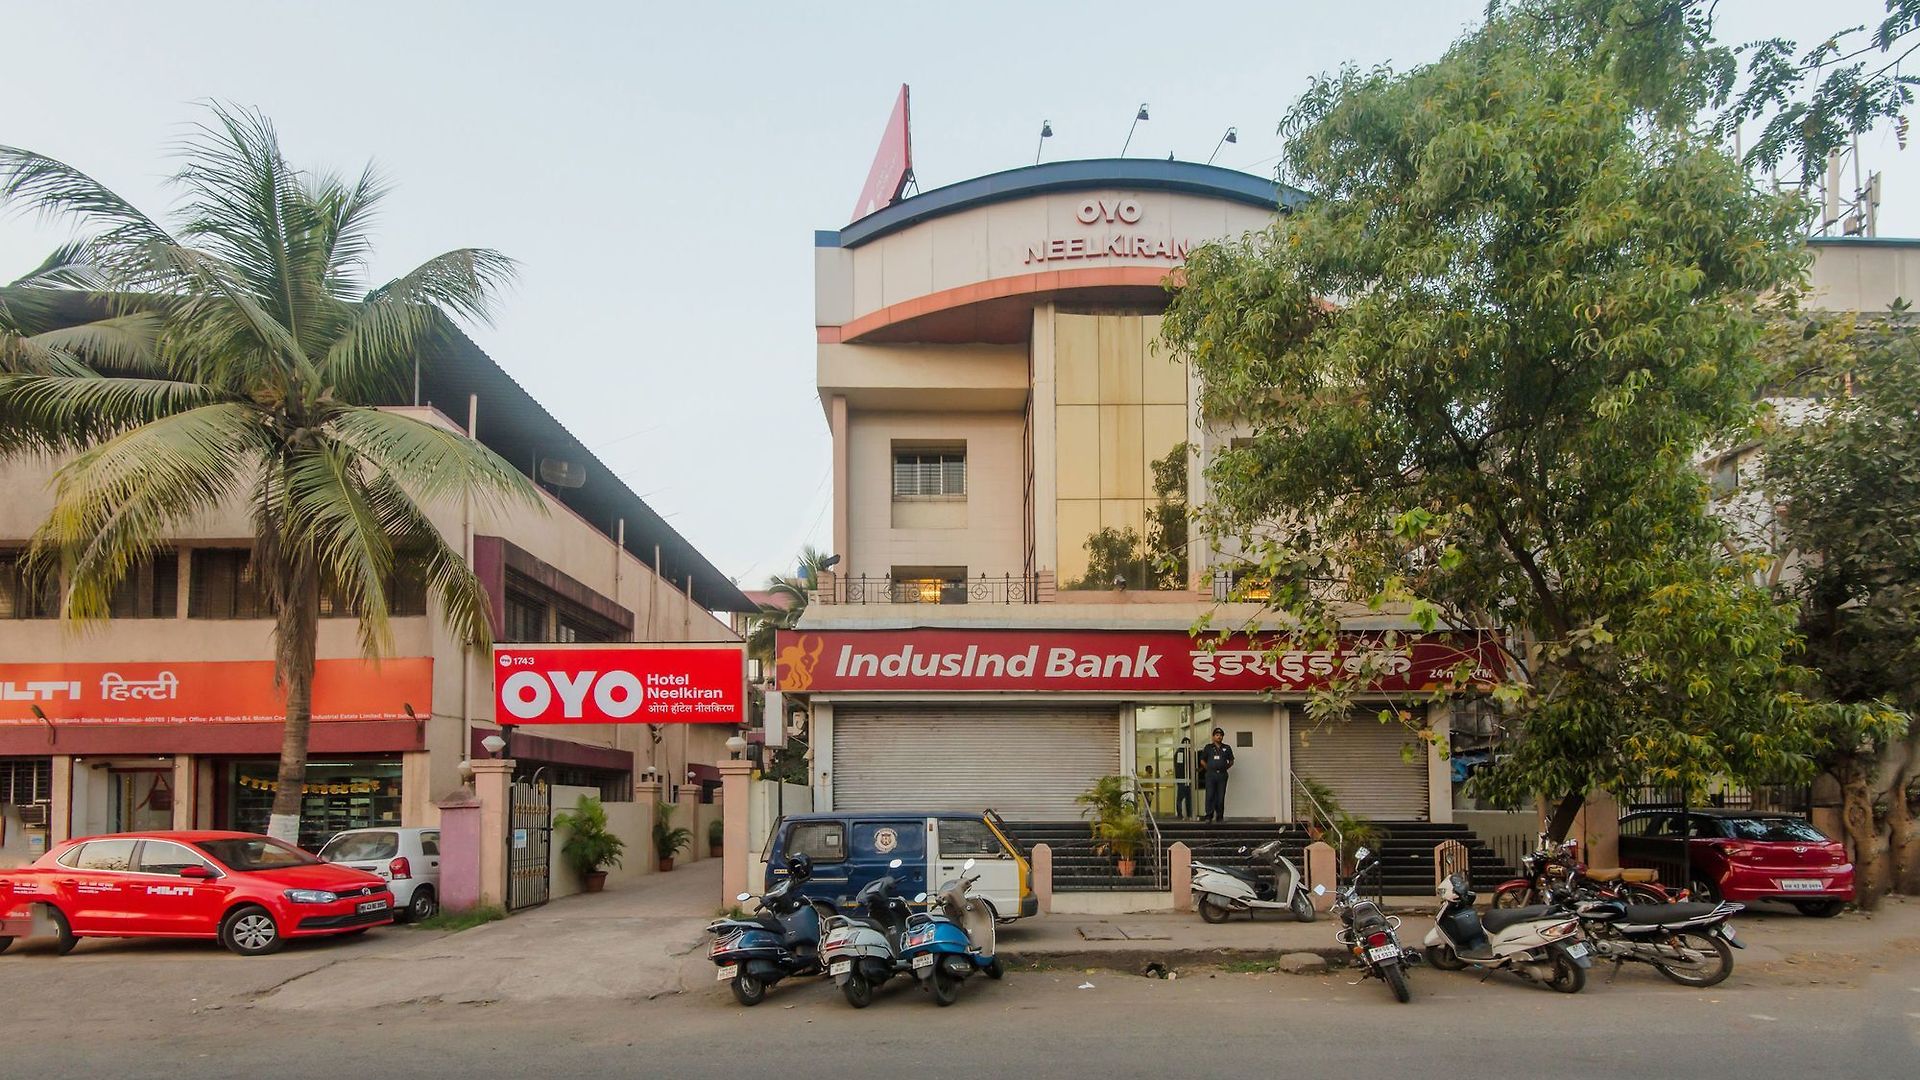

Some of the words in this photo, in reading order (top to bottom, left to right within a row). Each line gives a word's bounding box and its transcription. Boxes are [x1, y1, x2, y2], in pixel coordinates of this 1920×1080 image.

[1076, 198, 1143, 225] OYO
[1025, 234, 1189, 264] NEELKIRAN
[513, 657, 535, 665] 1743
[836, 644, 1038, 678] IndusInd
[1044, 645, 1163, 679] Bank
[647, 673, 689, 686] Hotel
[1429, 669, 1444, 679] 24
[100, 671, 179, 701] हिल्टी
[501, 670, 644, 719] OYO
[647, 687, 723, 699] Neelkiran
[648, 703, 668, 713] ओयो
[670, 702, 693, 714] हॉटेल
[694, 703, 734, 714] नीलकिरण
[147, 885, 194, 896] HILTI
